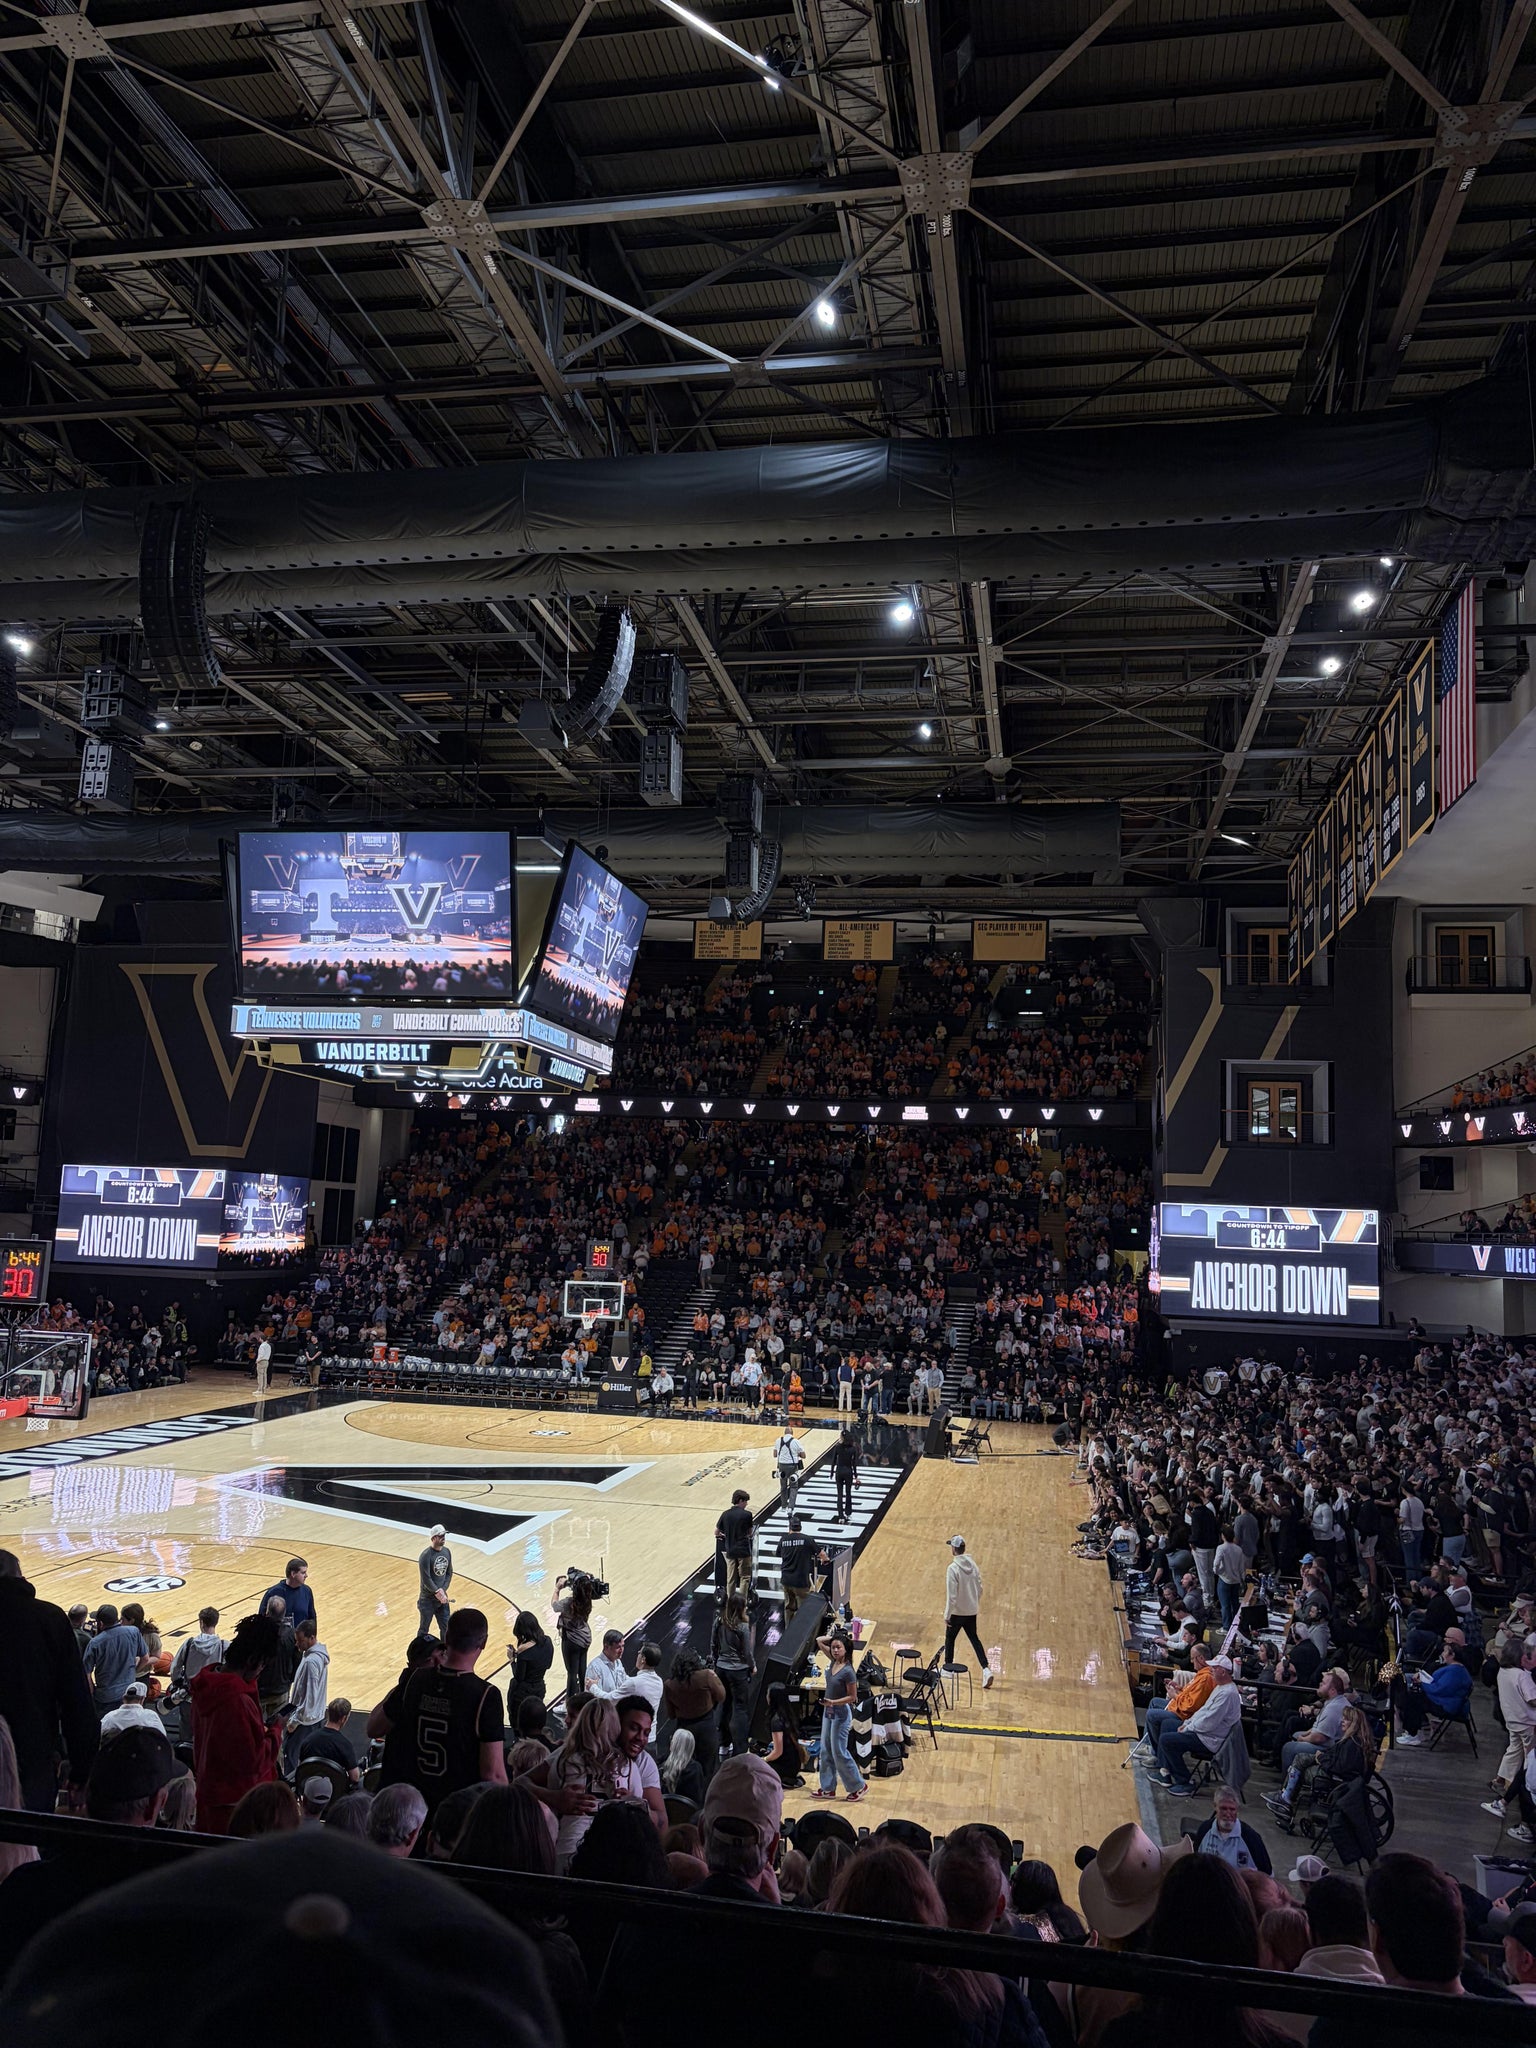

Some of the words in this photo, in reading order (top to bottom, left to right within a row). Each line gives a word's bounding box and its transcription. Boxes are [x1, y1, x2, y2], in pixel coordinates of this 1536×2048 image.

[344, 18, 358, 39] 1000
[927, 221, 936, 234] PT3
[300, 879, 349, 931] T
[386, 882, 448, 929] V
[839, 923, 880, 931] ALL-AMERICANS
[977, 923, 988, 931] SEC
[989, 923, 1009, 931] PLAYER
[1010, 923, 1017, 931] OF
[1018, 923, 1028, 931] THE
[1029, 923, 1043, 931] YEAR
[251, 1011, 301, 1029] TENNESSEE
[302, 1012, 361, 1030] VOLUNTEERS
[393, 1013, 450, 1031] VANDERBILT
[450, 1014, 521, 1032] COMMODORES
[316, 1042, 431, 1062] VANDERBILT
[499, 1072, 543, 1089] Acura
[549, 1057, 586, 1083] COMMODORES
[1226, 1222, 1273, 1230] COUNTDOWN
[77, 1215, 145, 1259] ANCHOR
[146, 1217, 198, 1261] DOWN
[1250, 1228, 1286, 1249] 6:44
[9, 1251, 40, 1267] 6:44
[592, 1253, 608, 1267] 30
[1471, 1245, 1492, 1271] V
[2, 1268, 34, 1298] 30
[1191, 1261, 1277, 1313] ANCHOR
[1282, 1265, 1348, 1316] DOWN
[611, 1356, 629, 1372] V
[609, 1383, 632, 1393] Hiller
[1205, 1376, 1220, 1391] V
[836, 1561, 849, 1597] V
[417, 1715, 448, 1777] 5
